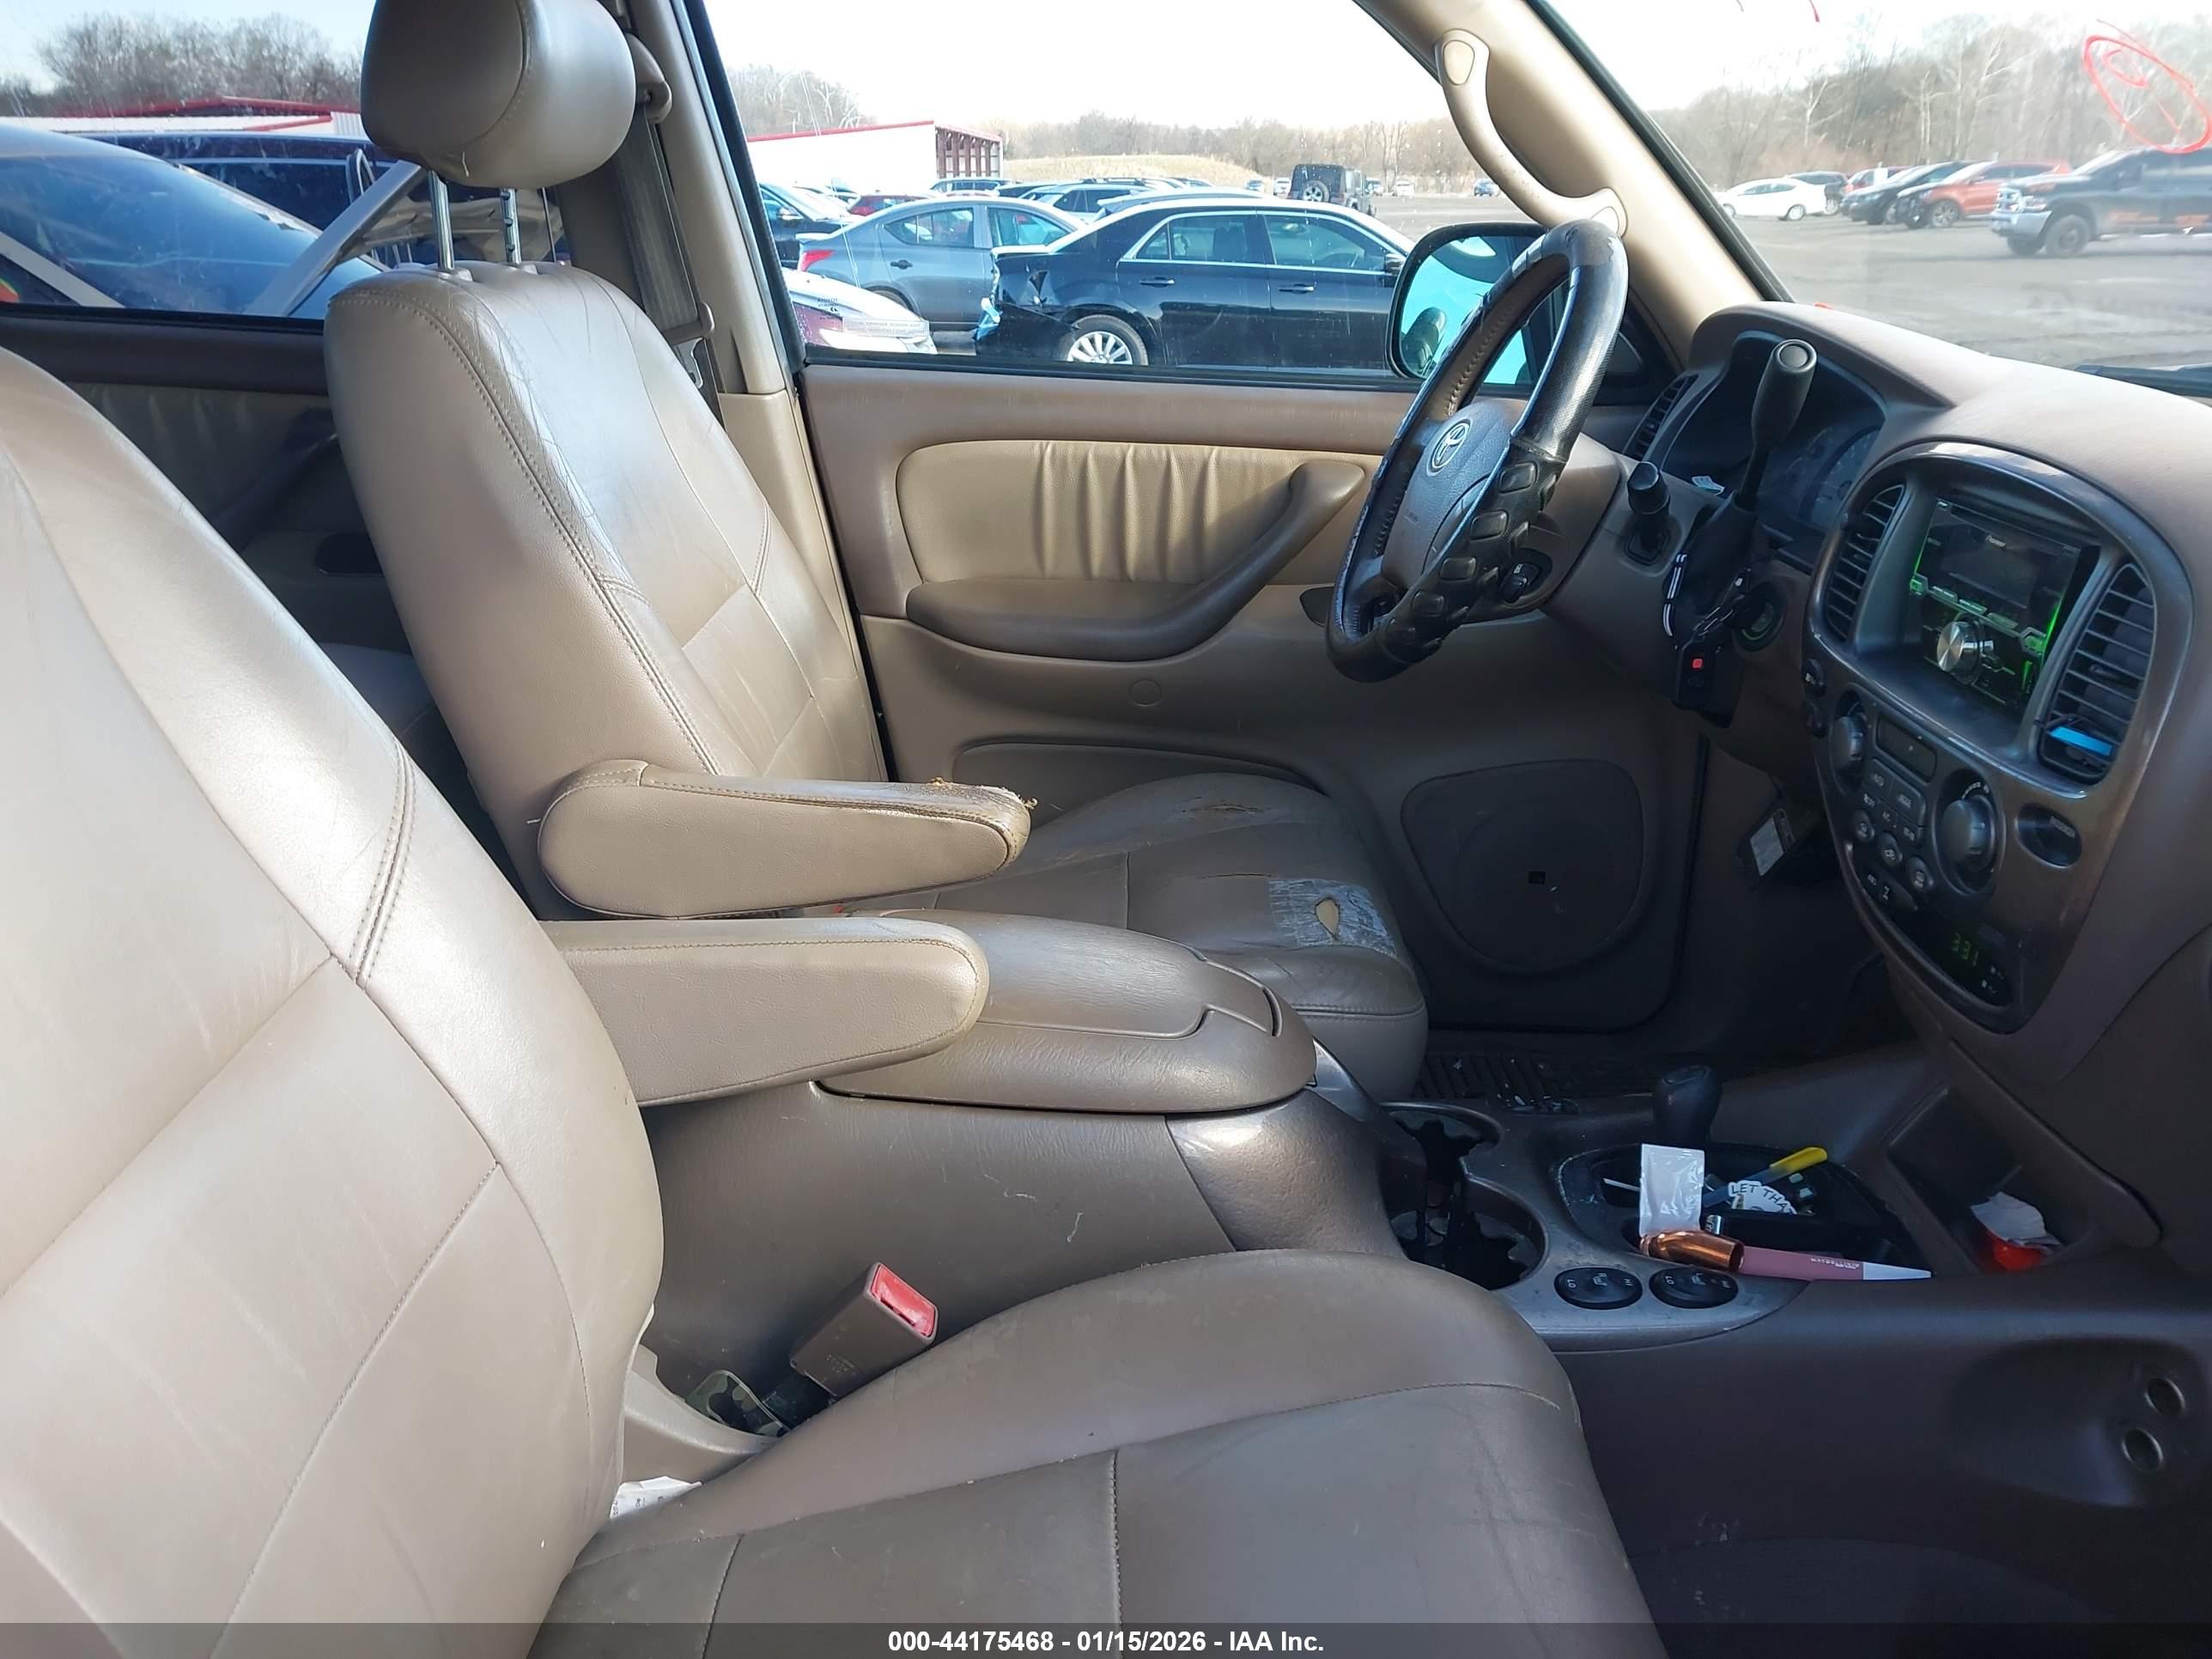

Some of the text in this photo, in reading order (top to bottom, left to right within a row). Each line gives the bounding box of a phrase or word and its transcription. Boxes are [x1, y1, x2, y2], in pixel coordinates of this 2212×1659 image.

[1731, 1182, 1759, 1194] LET
[1565, 1278, 1577, 1289] LO
[1663, 1275, 1674, 1285] LO
